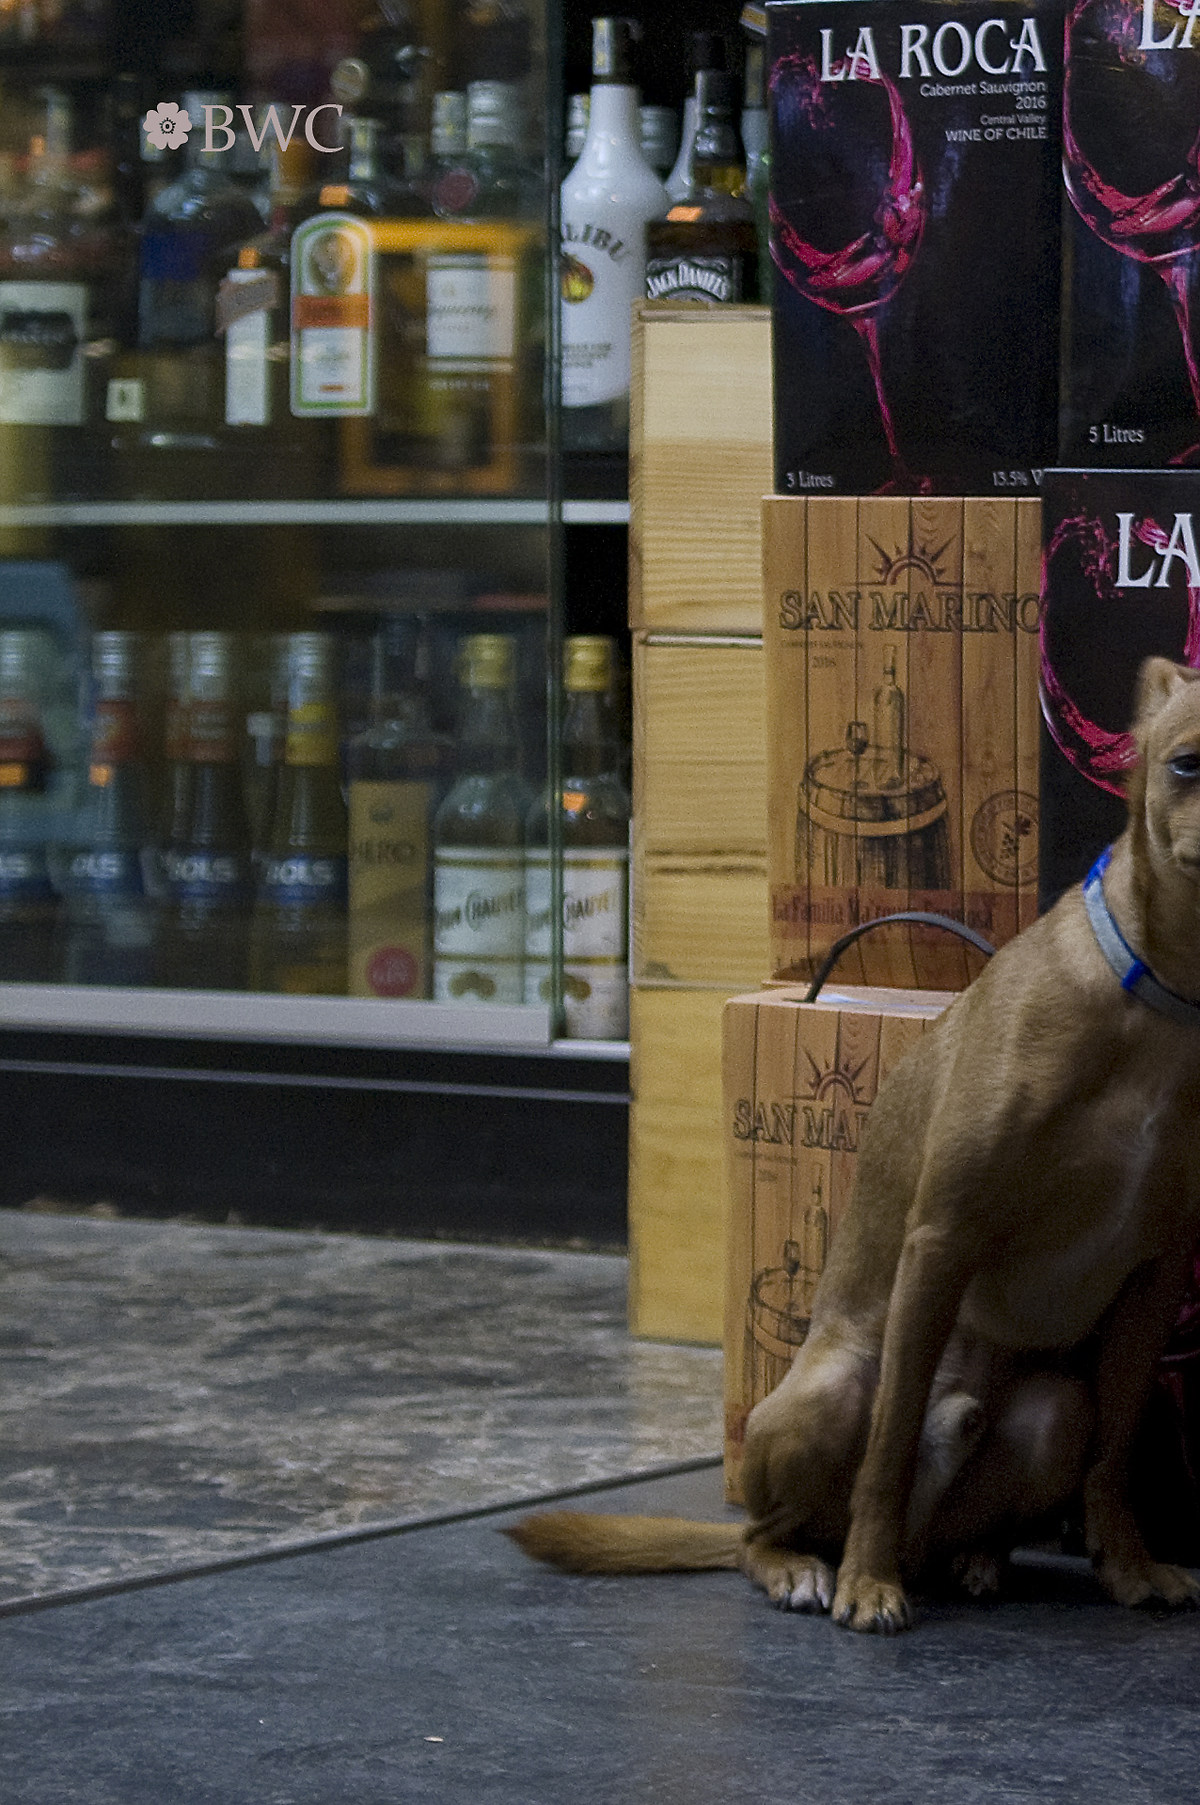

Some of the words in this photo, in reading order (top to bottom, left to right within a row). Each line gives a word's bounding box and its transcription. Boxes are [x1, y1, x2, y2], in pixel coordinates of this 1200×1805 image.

[820, 26, 883, 82] LA
[898, 18, 1049, 78] ROCA
[919, 82, 976, 98] Cabernet
[979, 80, 1047, 97] Sauvignon
[1015, 95, 1048, 110] 2016
[945, 129, 980, 143] WINE
[983, 128, 1004, 141] OF
[1005, 126, 1048, 141] CHILE
[563, 222, 626, 262] LIBU
[646, 268, 678, 299] JACK
[1088, 427, 1099, 443] 5
[1102, 424, 1146, 444] Litres
[779, 588, 861, 632] SAN
[868, 589, 1041, 633] MARINO
[732, 1096, 798, 1146] SAN
